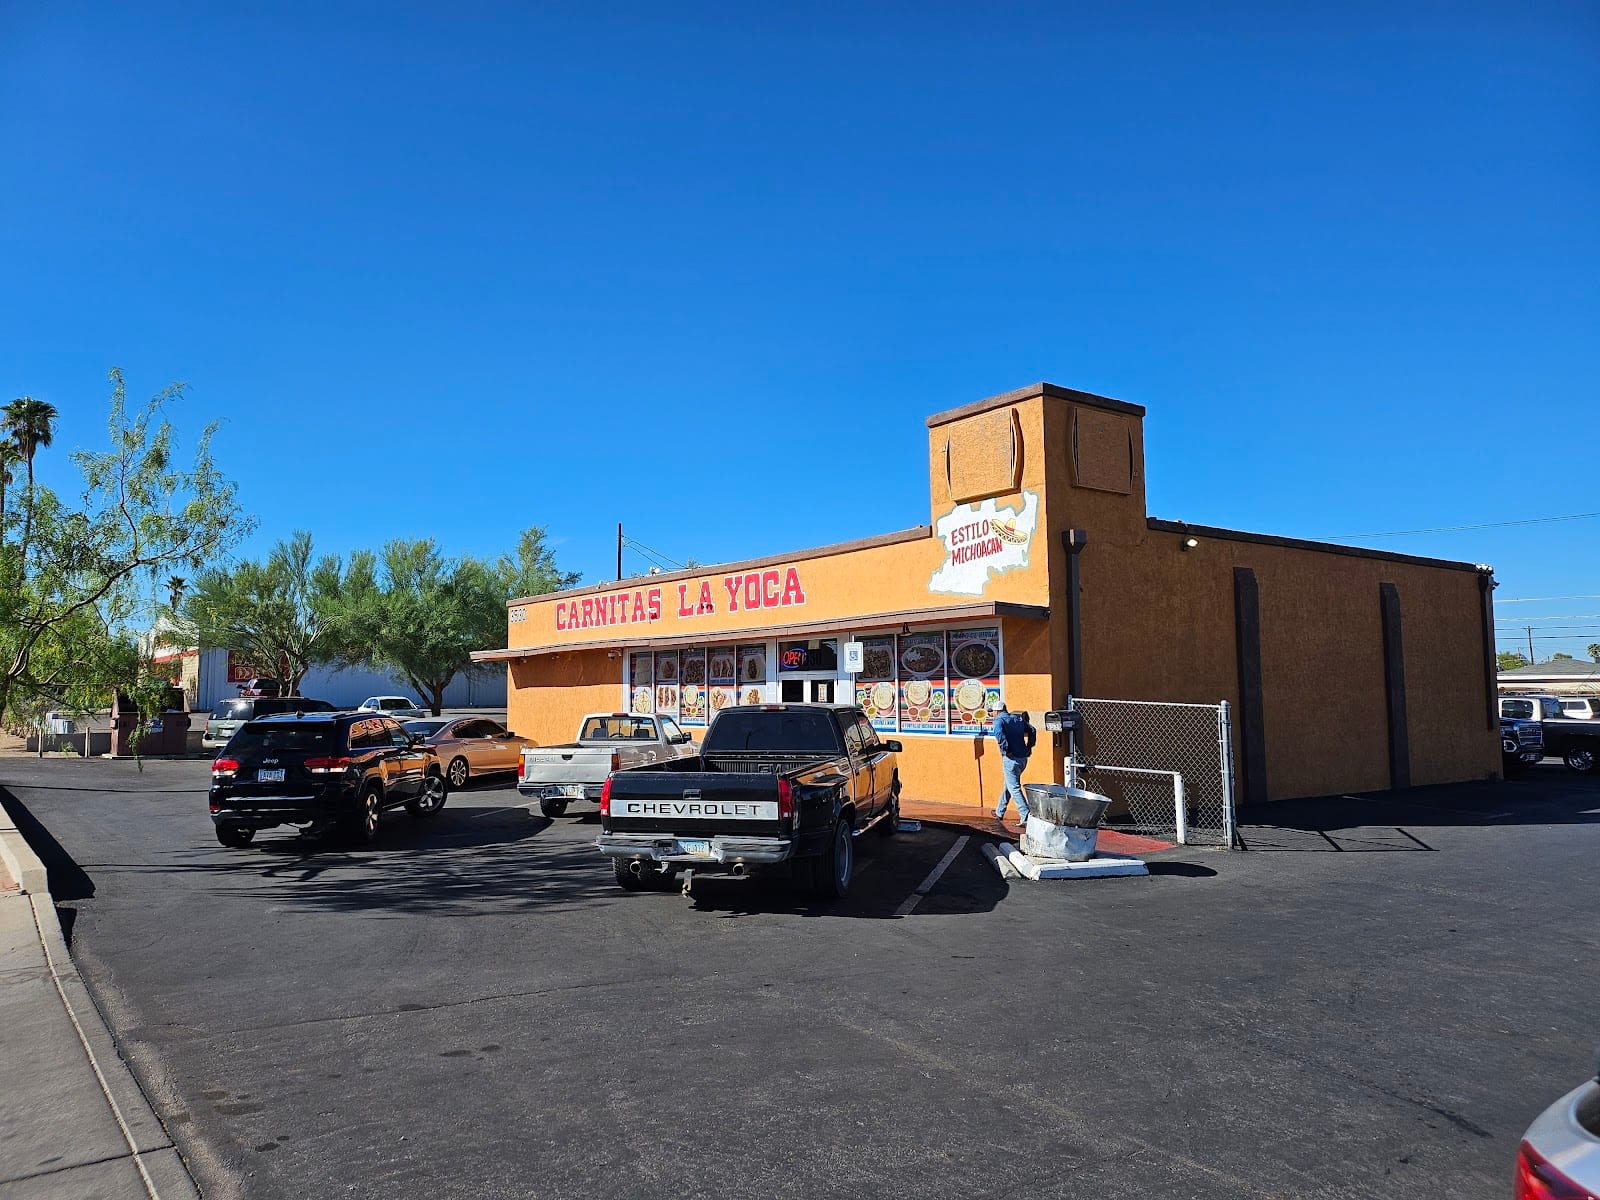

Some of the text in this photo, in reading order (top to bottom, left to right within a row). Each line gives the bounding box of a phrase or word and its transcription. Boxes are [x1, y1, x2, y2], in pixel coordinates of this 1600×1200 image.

[950, 519, 990, 546] ESTILO
[951, 537, 1003, 567] MICHOACAN
[556, 566, 807, 632] CARNITAS LA YOCA
[782, 649, 807, 666] OPEN
[262, 757, 279, 765] Jeep
[627, 803, 762, 816] CHEVROLET
